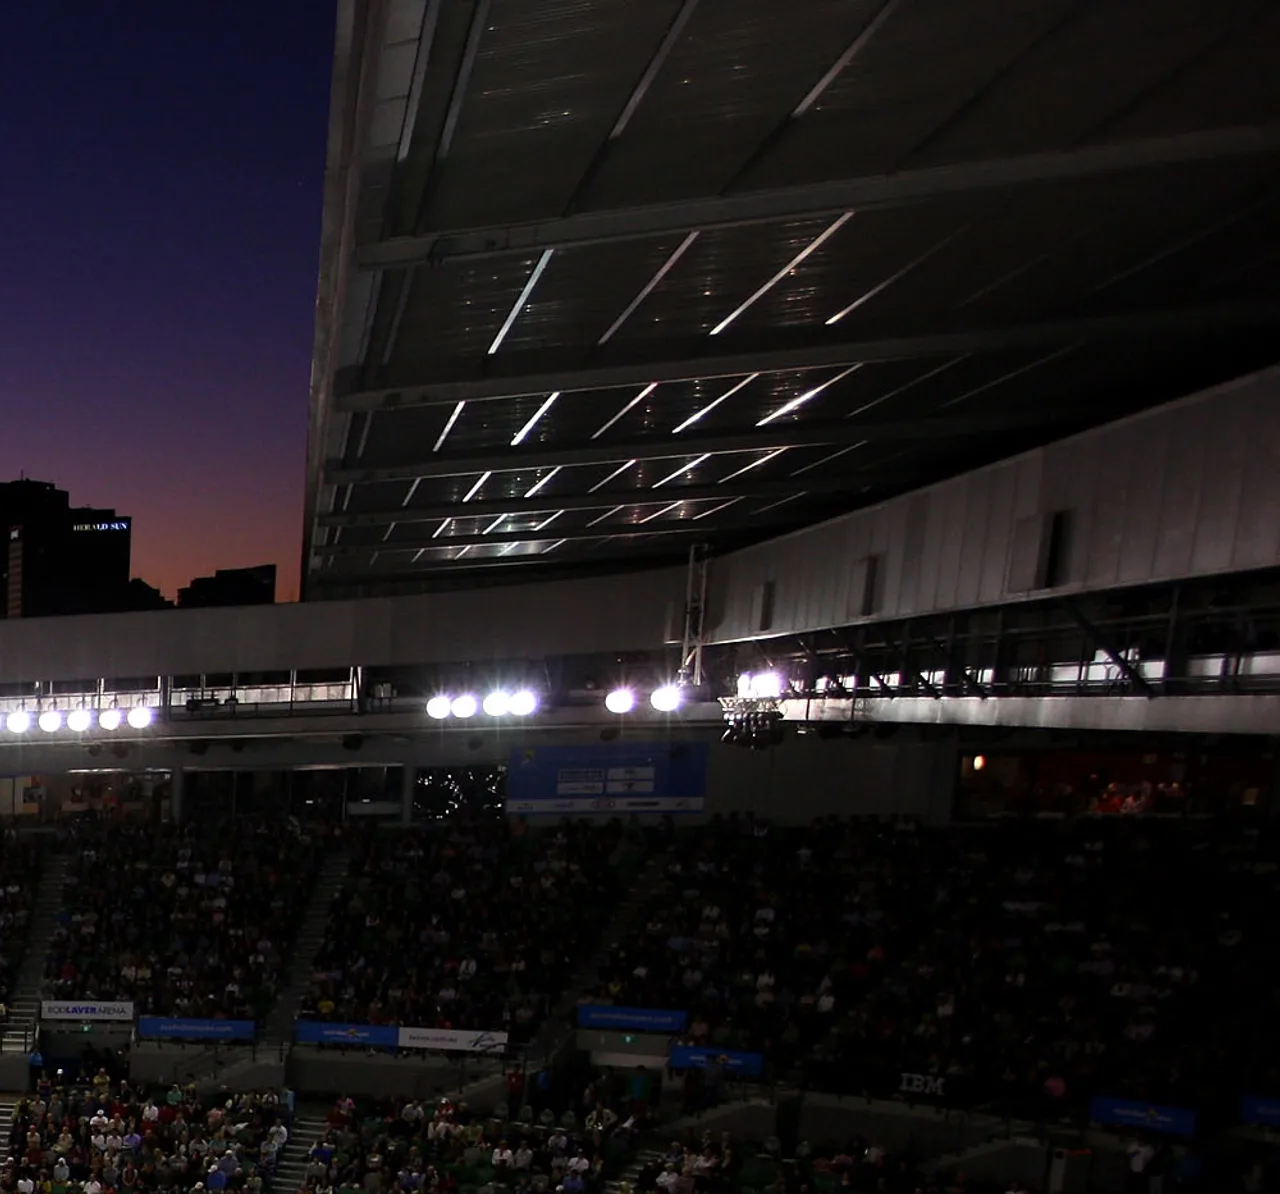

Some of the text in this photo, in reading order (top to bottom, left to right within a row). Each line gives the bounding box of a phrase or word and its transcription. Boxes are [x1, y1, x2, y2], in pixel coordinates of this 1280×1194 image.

[73, 522, 128, 532] HERALD SUN
[899, 1072, 946, 1096] IBM
